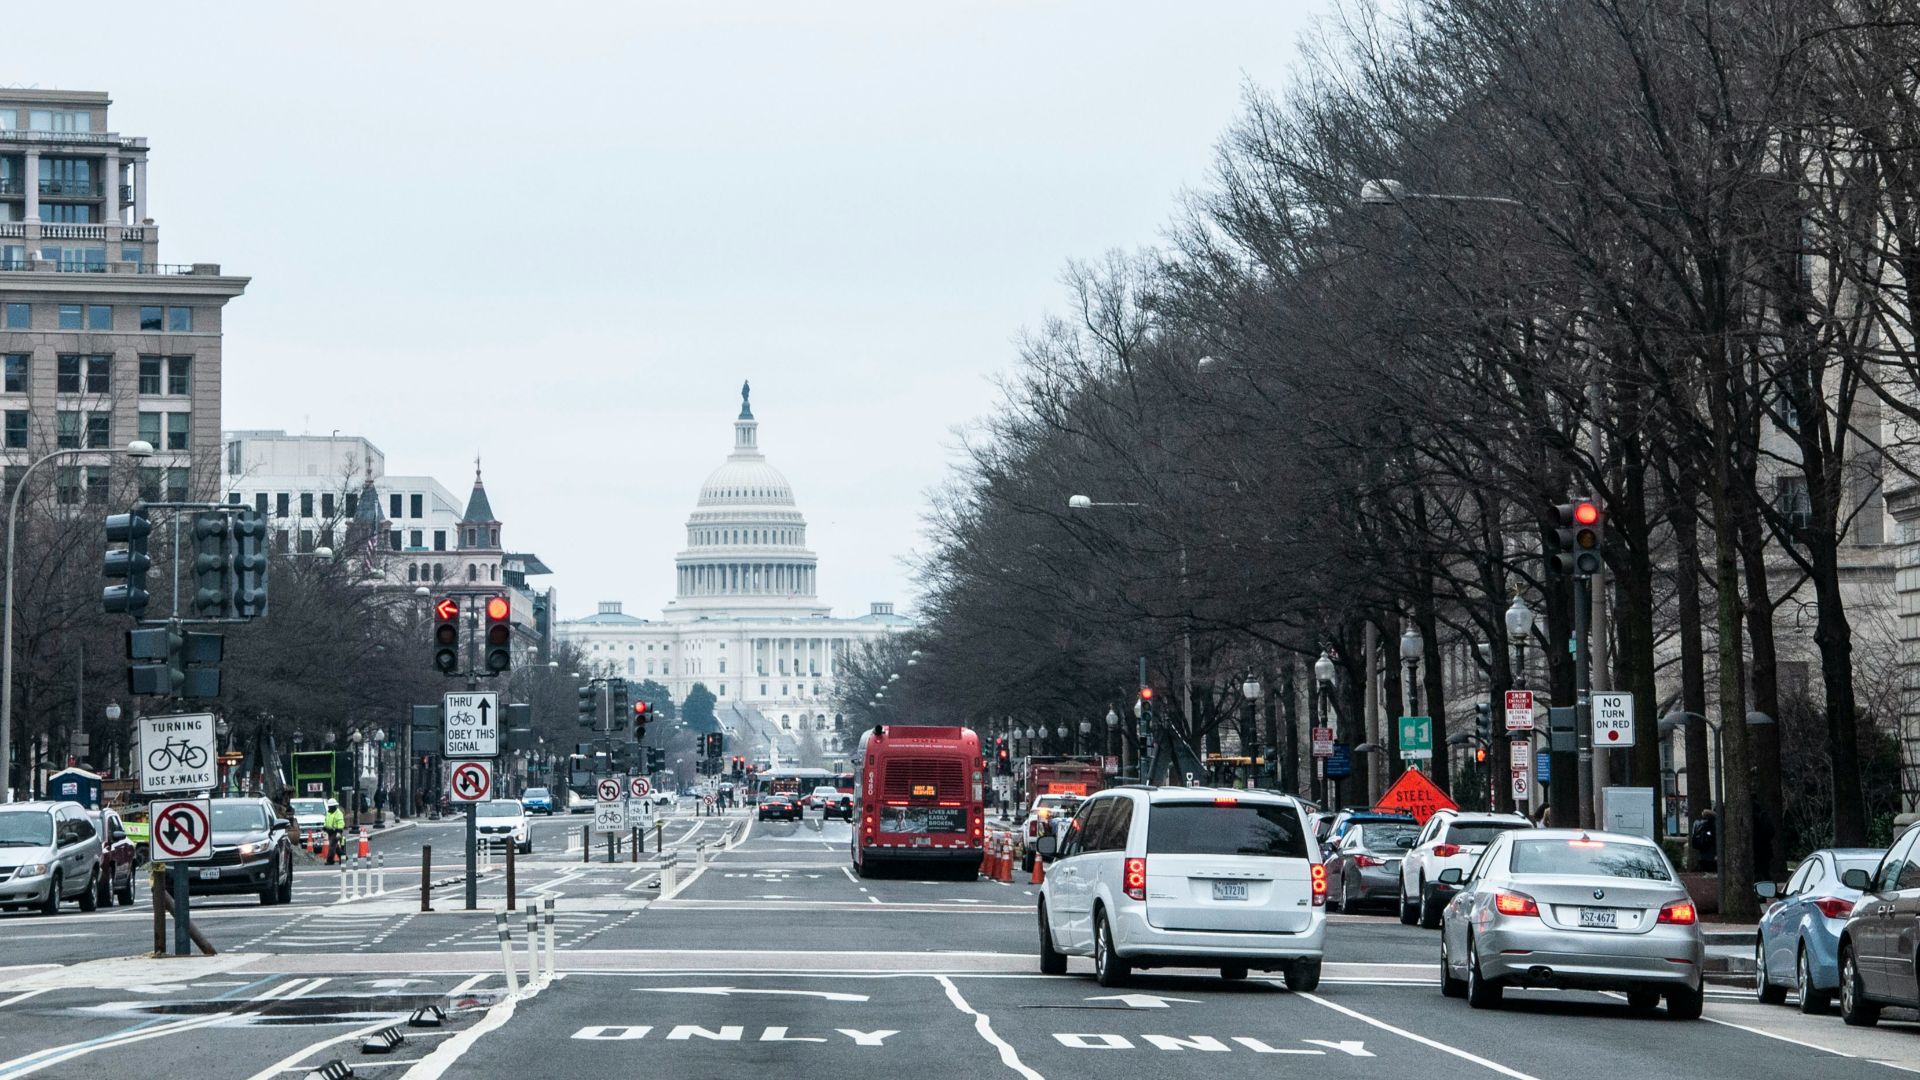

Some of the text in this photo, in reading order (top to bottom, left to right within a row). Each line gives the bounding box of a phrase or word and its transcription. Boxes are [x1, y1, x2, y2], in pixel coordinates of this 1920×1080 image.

[448, 696, 472, 707] THRU
[1604, 698, 1620, 708] NO
[1601, 710, 1624, 718] TURN
[152, 720, 202, 733] TURNING
[449, 728, 495, 740] OBEY THIS
[449, 741, 480, 751] SIGNAL
[149, 773, 209, 786] USE X-WALKS
[1396, 790, 1432, 801] STEEL
[1224, 886, 1244, 895] 17270
[570, 1025, 901, 1046] ONLY
[1052, 1033, 1377, 1057] ONLY
